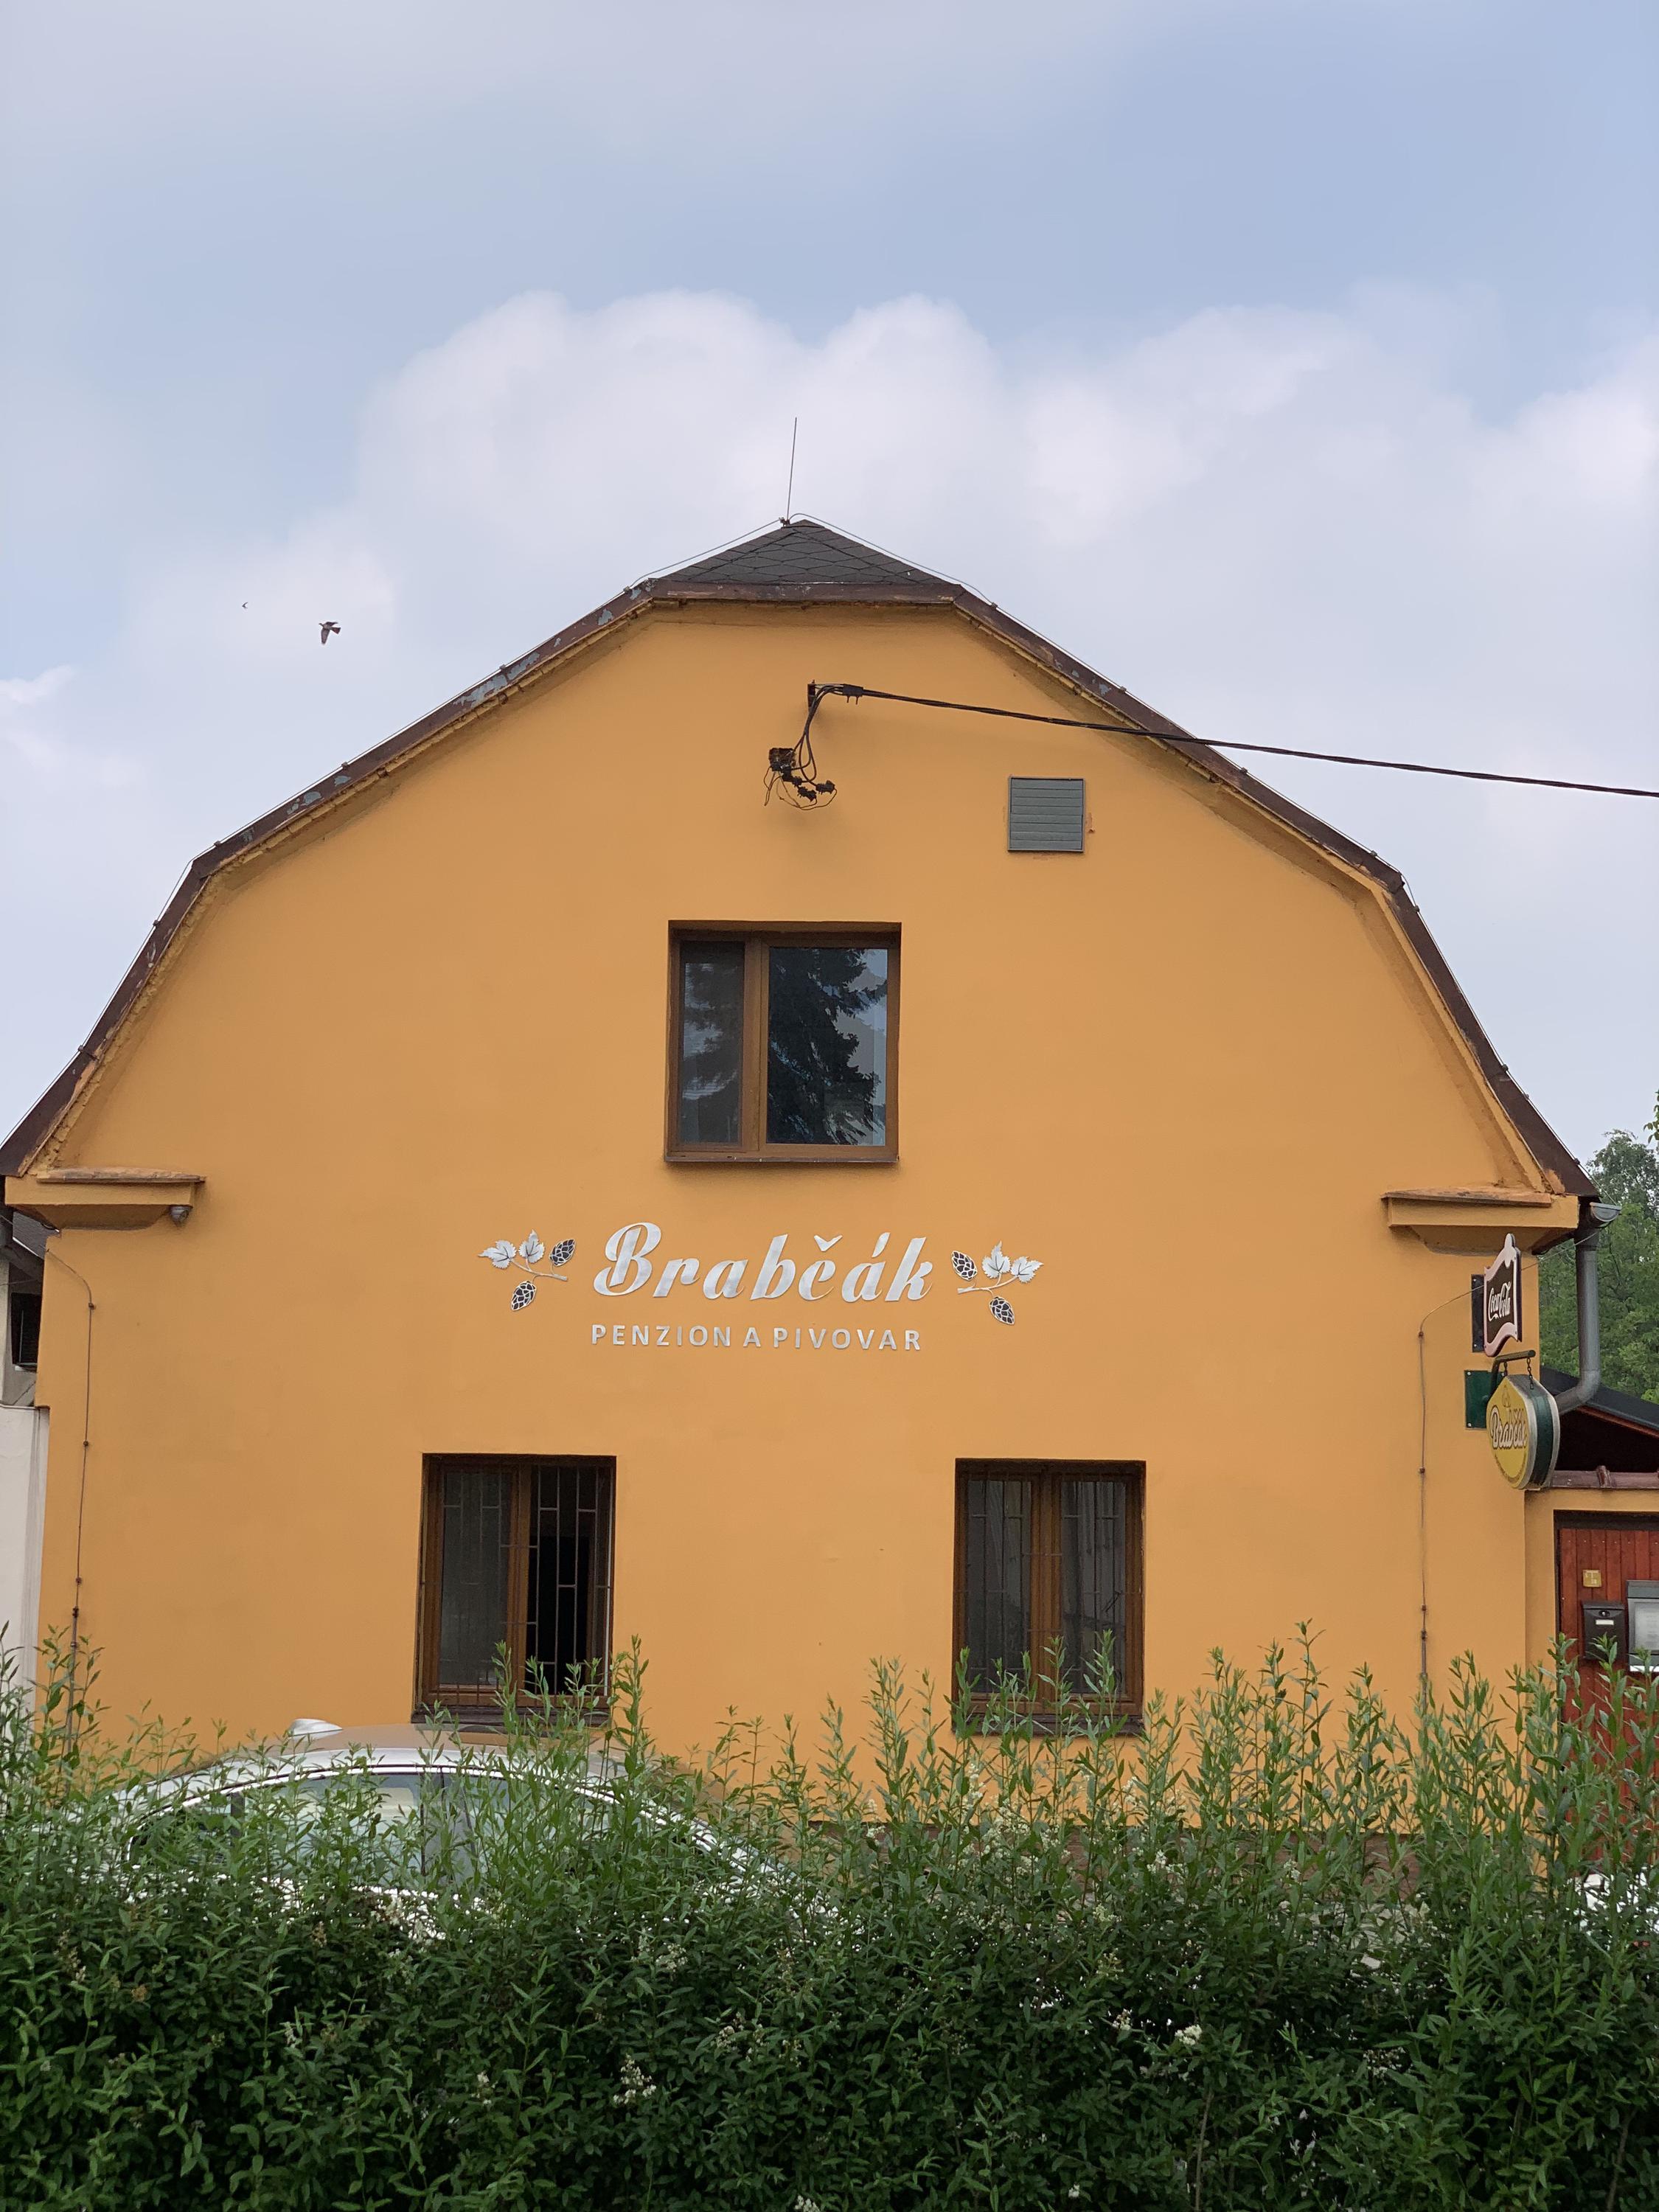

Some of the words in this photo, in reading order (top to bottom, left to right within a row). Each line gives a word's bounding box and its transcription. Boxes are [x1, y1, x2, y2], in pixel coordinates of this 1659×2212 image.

[593, 1221, 933, 1303] Brabčák
[591, 1324, 731, 1347] PENZION
[742, 1326, 762, 1348] A
[773, 1326, 921, 1351] PIVOVAR
